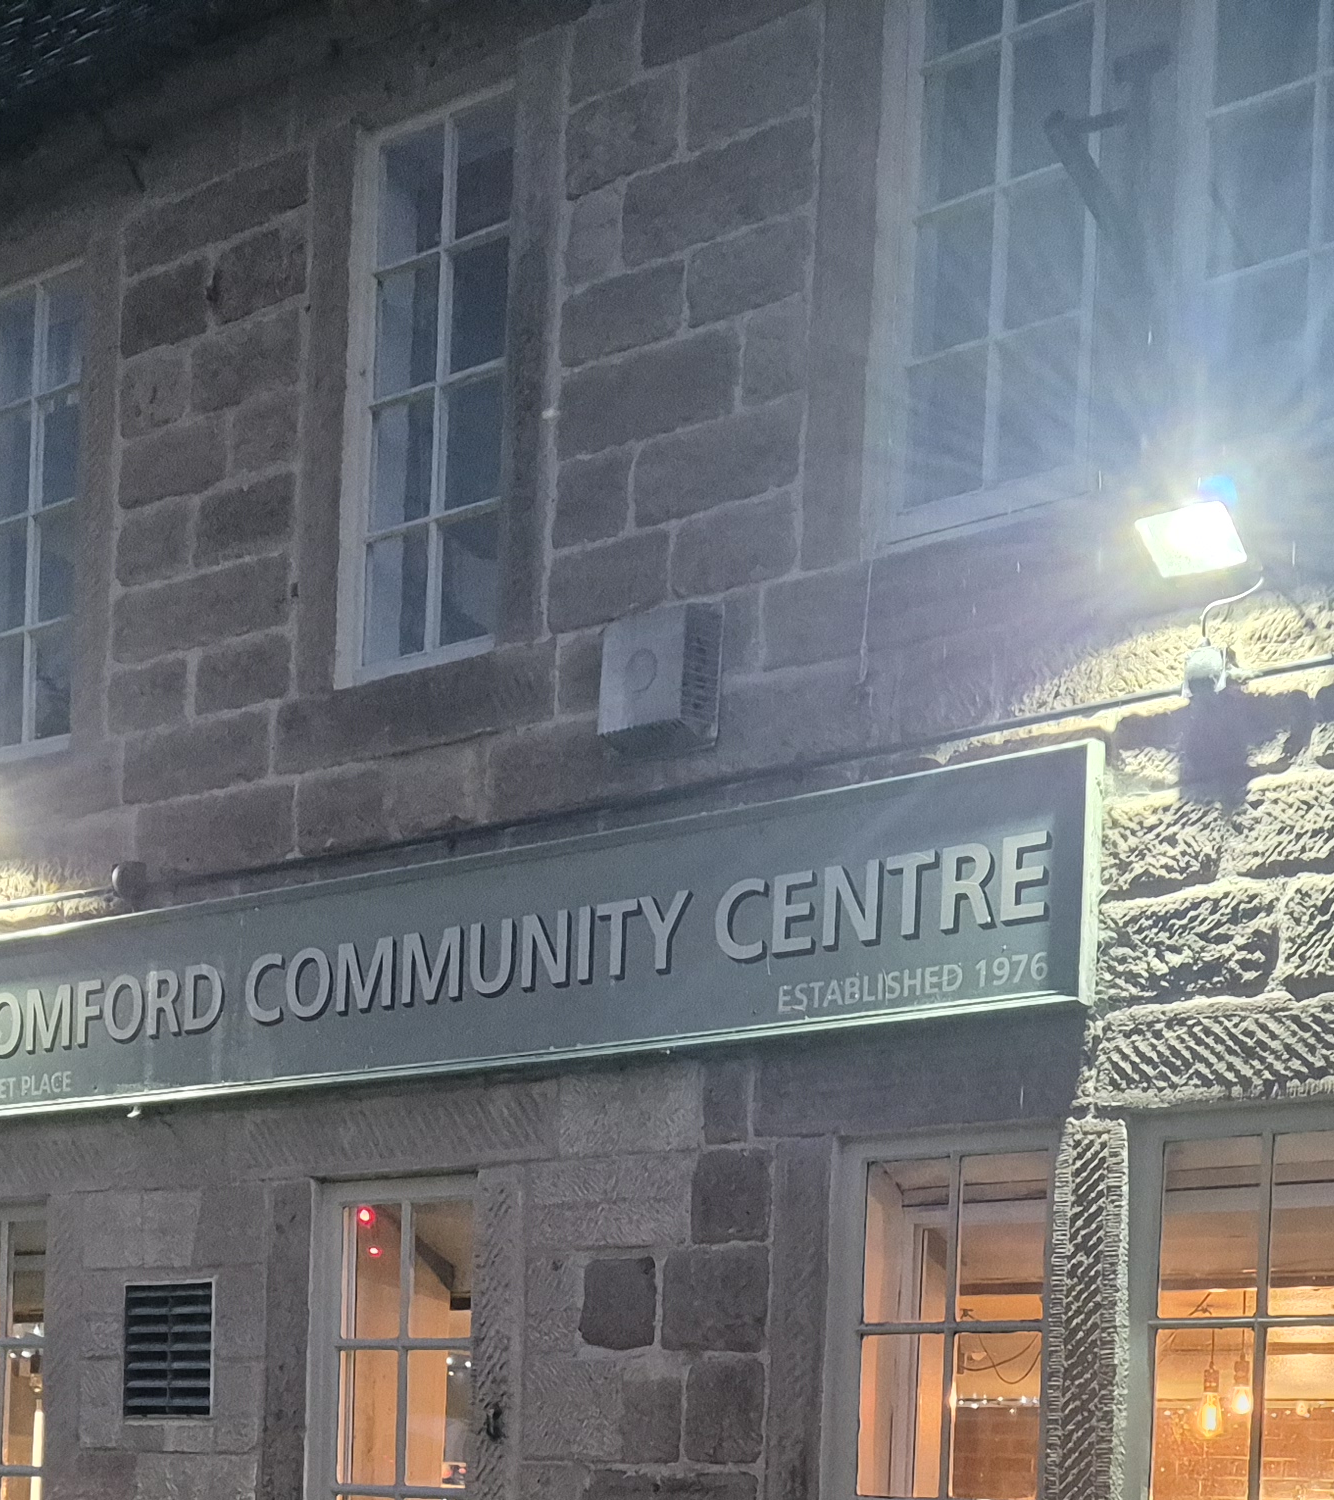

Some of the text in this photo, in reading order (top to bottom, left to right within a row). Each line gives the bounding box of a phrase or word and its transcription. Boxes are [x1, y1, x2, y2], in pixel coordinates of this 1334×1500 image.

[244, 889, 692, 1023] COMMUNITY
[714, 830, 1050, 961] CENTRE
[778, 952, 1048, 1014] ESTABLISHED 1976
[21, 1071, 72, 1096] PLACE
